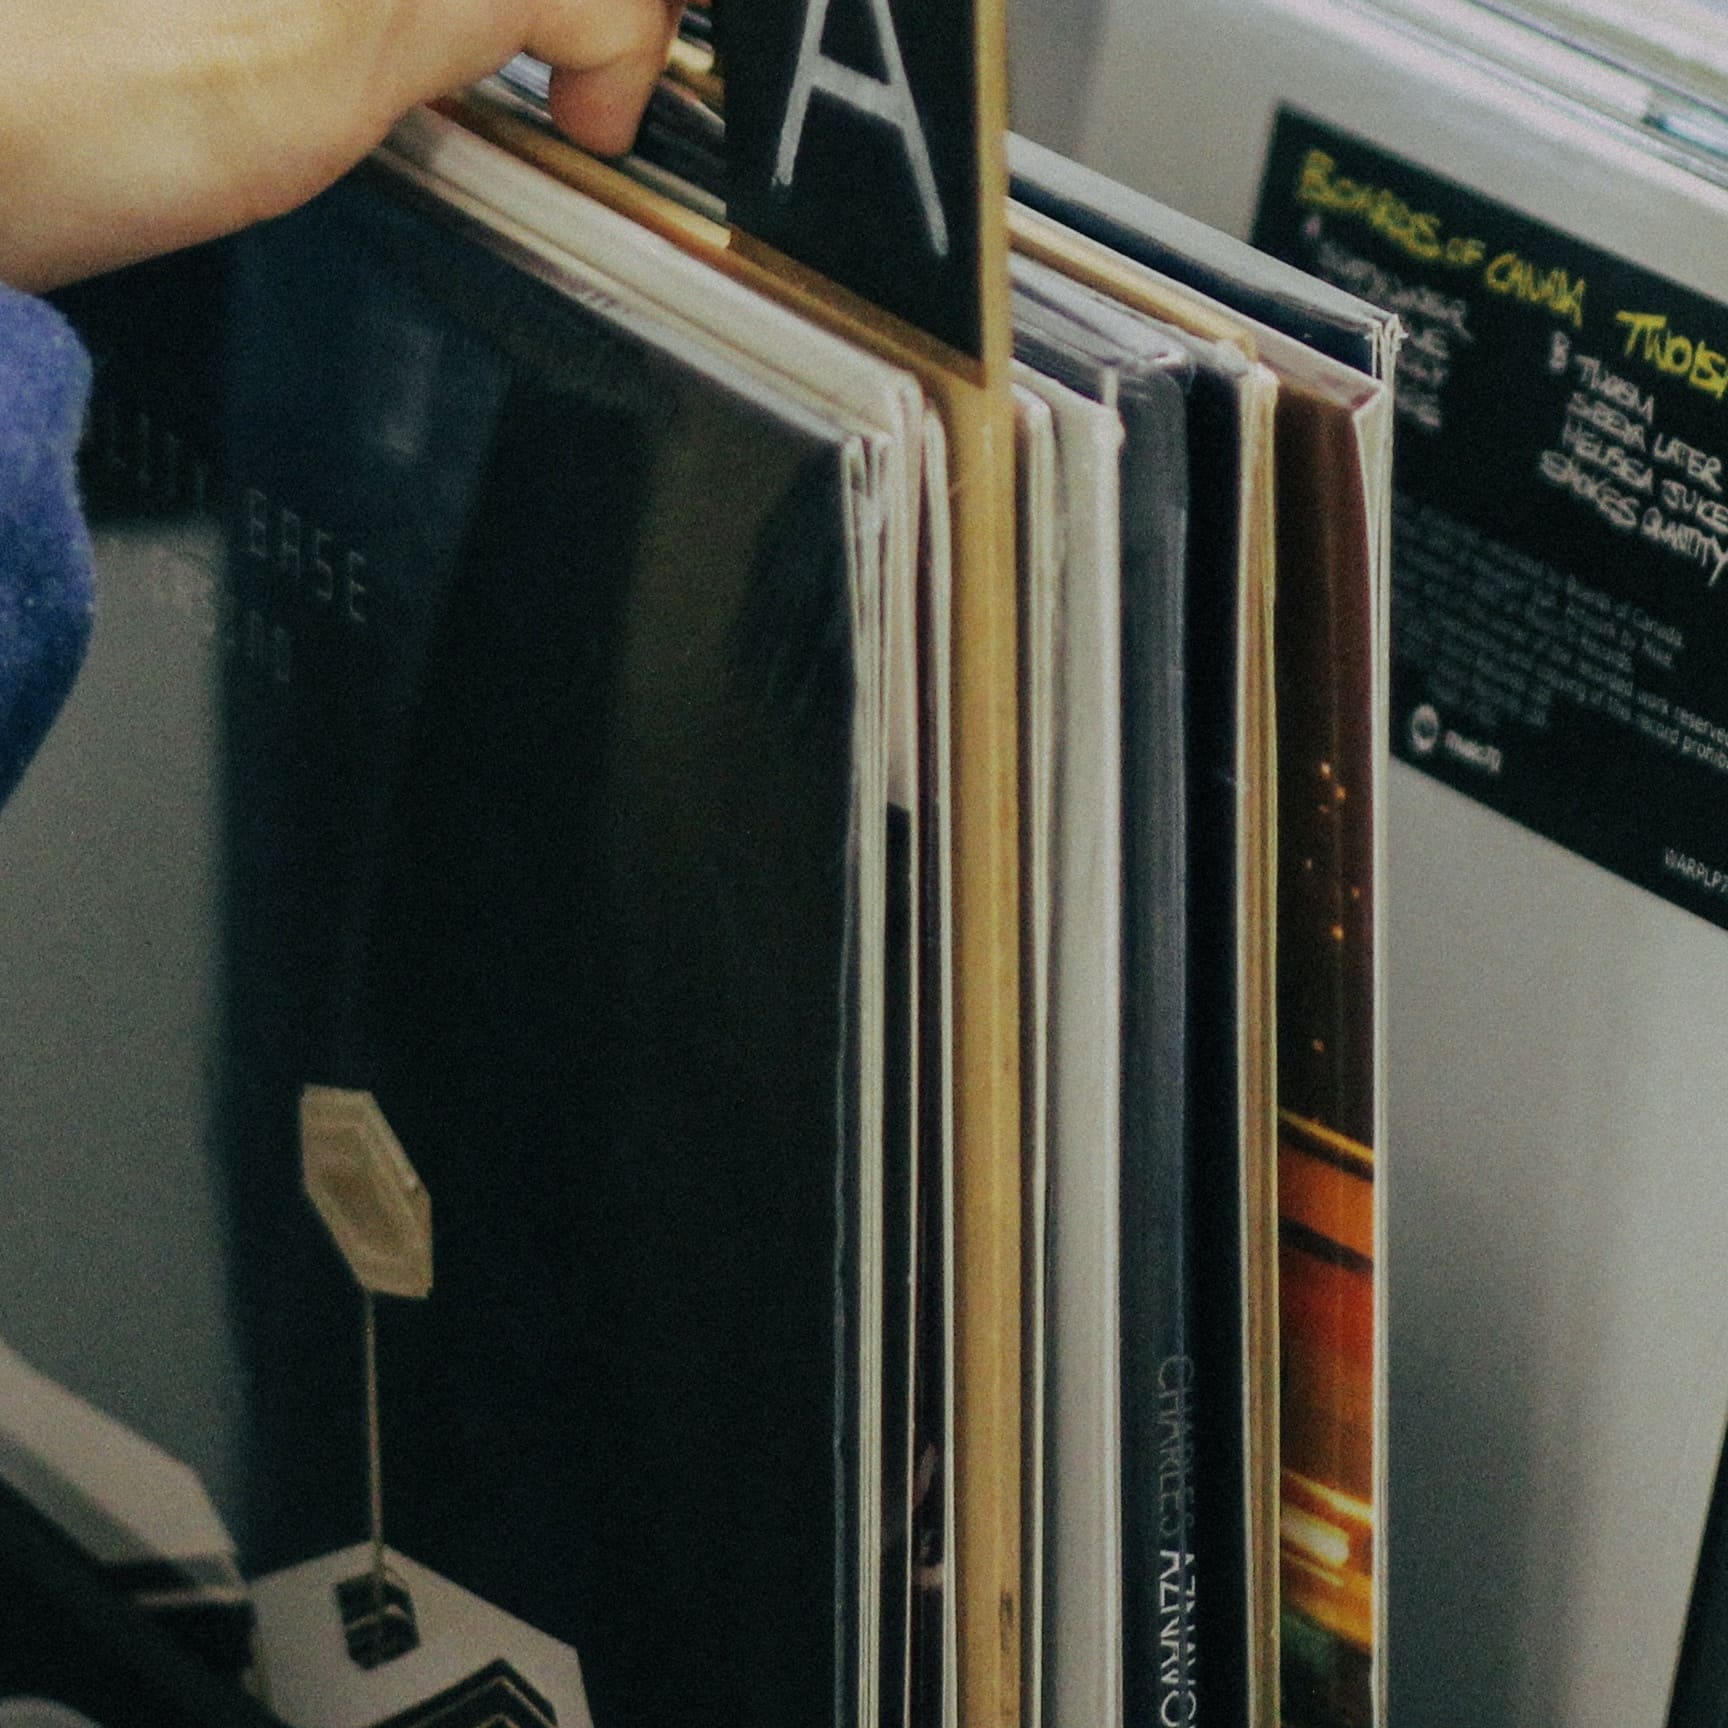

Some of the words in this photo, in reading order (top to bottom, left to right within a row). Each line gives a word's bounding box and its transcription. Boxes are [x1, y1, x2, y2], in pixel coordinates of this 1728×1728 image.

[1654, 432, 1721, 492] LATER
[1158, 1354, 1196, 1540] CHARLES
[1159, 1549, 1197, 1728] AZNAVO
